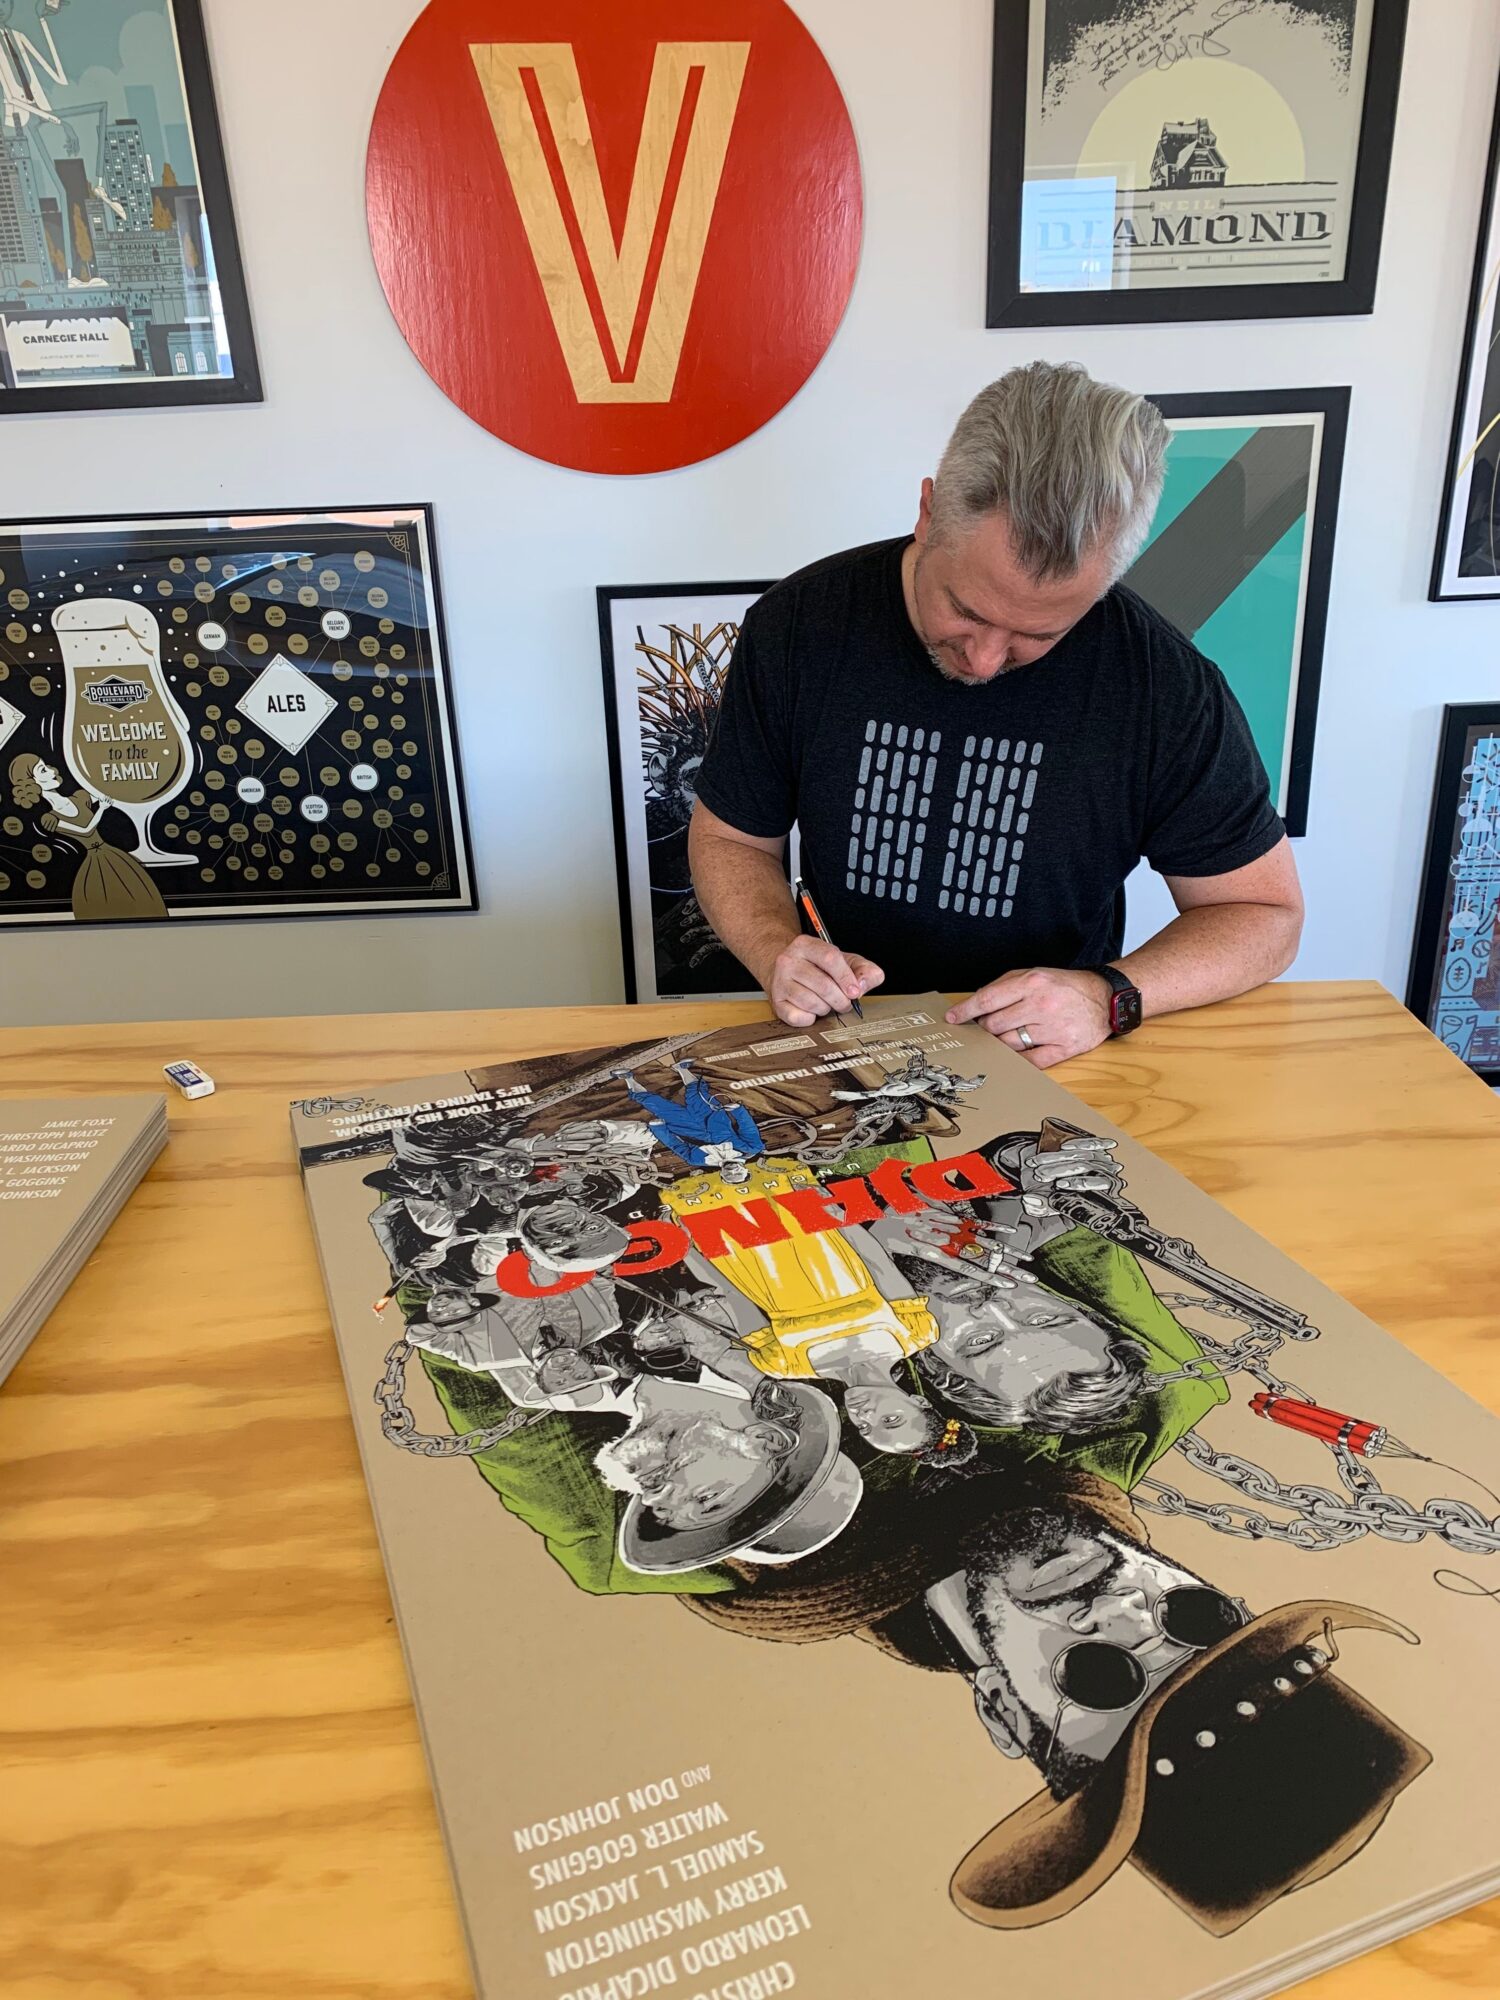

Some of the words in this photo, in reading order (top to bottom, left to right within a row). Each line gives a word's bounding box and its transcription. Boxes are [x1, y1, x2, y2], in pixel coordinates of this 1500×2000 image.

[1157, 199, 1217, 212] NEIL
[468, 42, 751, 403] V
[1037, 210, 1334, 253] DIAMOND
[22, 333, 77, 344] CARNEGIE
[79, 332, 109, 342] HALL
[90, 685, 143, 701] BOULEVARD
[267, 694, 306, 713] ALES
[80, 722, 168, 742] WELCOME
[109, 747, 122, 760] to
[126, 744, 149, 760] the
[101, 761, 159, 781] FAMILY
[926, 1032, 945, 1041] LIKE
[941, 1040, 964, 1049] THE
[844, 1048, 862, 1056] DIE
[876, 1052, 892, 1062] BY
[892, 1047, 922, 1059] FILM
[811, 1056, 875, 1075] QUENTIN
[729, 1068, 813, 1090] TARANTINO
[496, 1084, 532, 1099] HE'S
[436, 1092, 494, 1109] TAKING
[495, 1096, 535, 1111] THEY
[327, 1102, 432, 1127] EVERYTHING.
[414, 1111, 444, 1125] HIS
[445, 1103, 494, 1119] TOOK
[41, 1119, 81, 1129] JAMIE
[82, 1117, 116, 1127] FOXX
[330, 1116, 412, 1138] FREEDOM.
[67, 1128, 108, 1138] WALTZ
[38, 1140, 98, 1151] DICAPRIO
[4, 1151, 90, 1163] WASHINGTON
[20, 1164, 80, 1175] JACKSON
[6, 1176, 68, 1187] GOGGINS
[680, 1763, 712, 1788] AND
[627, 1777, 680, 1813] DON
[513, 1796, 622, 1854] JOHNSON
[639, 1801, 730, 1850] WALTER
[529, 1833, 638, 1890] GOGGINS
[670, 1829, 766, 1882] SAMUEL
[713, 1866, 789, 1915] KERRY
[534, 1873, 640, 1934] JACKSON
[544, 1896, 712, 1978] WASHINGTON
[681, 1904, 813, 1976] LEONARDO
